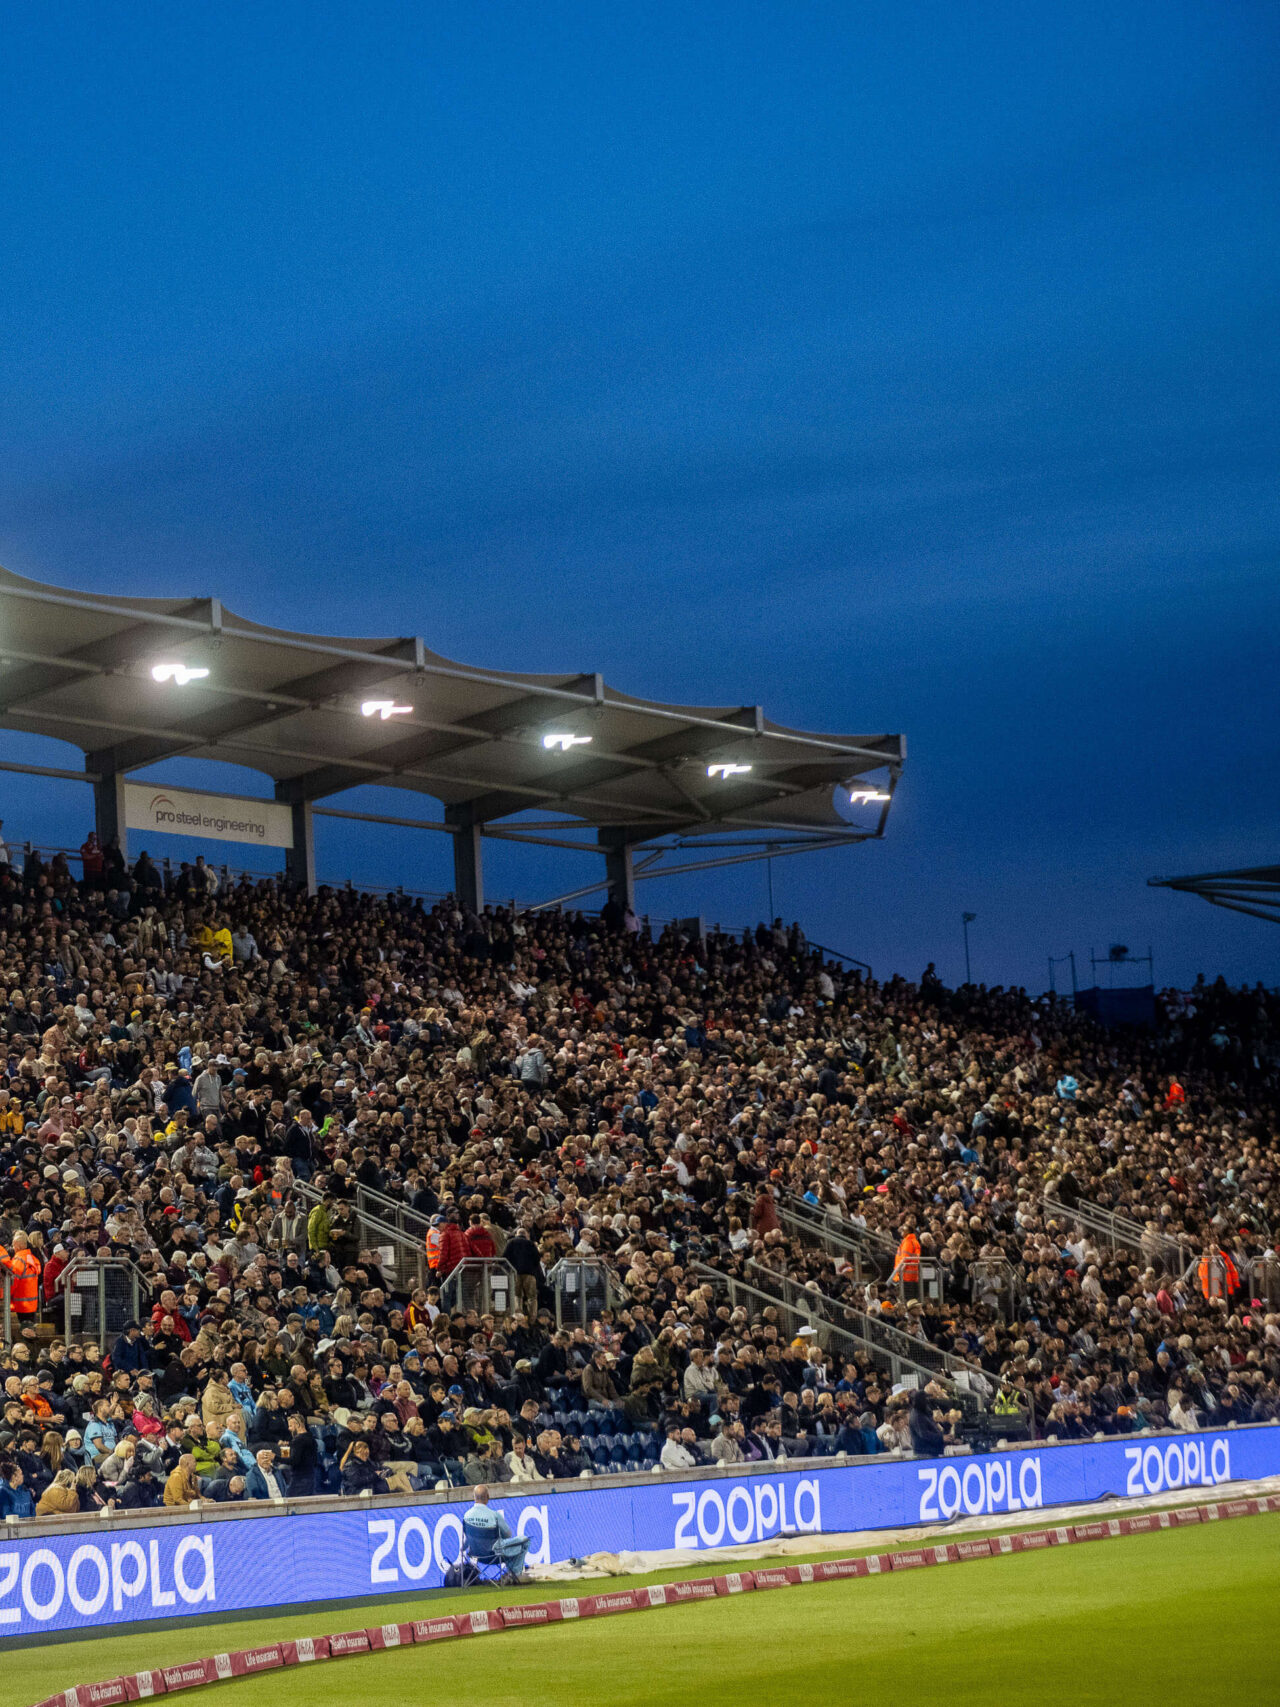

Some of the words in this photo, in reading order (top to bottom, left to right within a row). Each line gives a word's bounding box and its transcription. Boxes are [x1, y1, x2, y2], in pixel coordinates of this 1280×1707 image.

[156, 809, 176, 824] pro
[176, 812, 202, 828] steel
[202, 816, 265, 837] engineering
[416, 1623, 428, 1636] Life
[428, 1620, 454, 1635] insurance
[244, 1653, 256, 1667] Life
[255, 1649, 279, 1665] insurance
